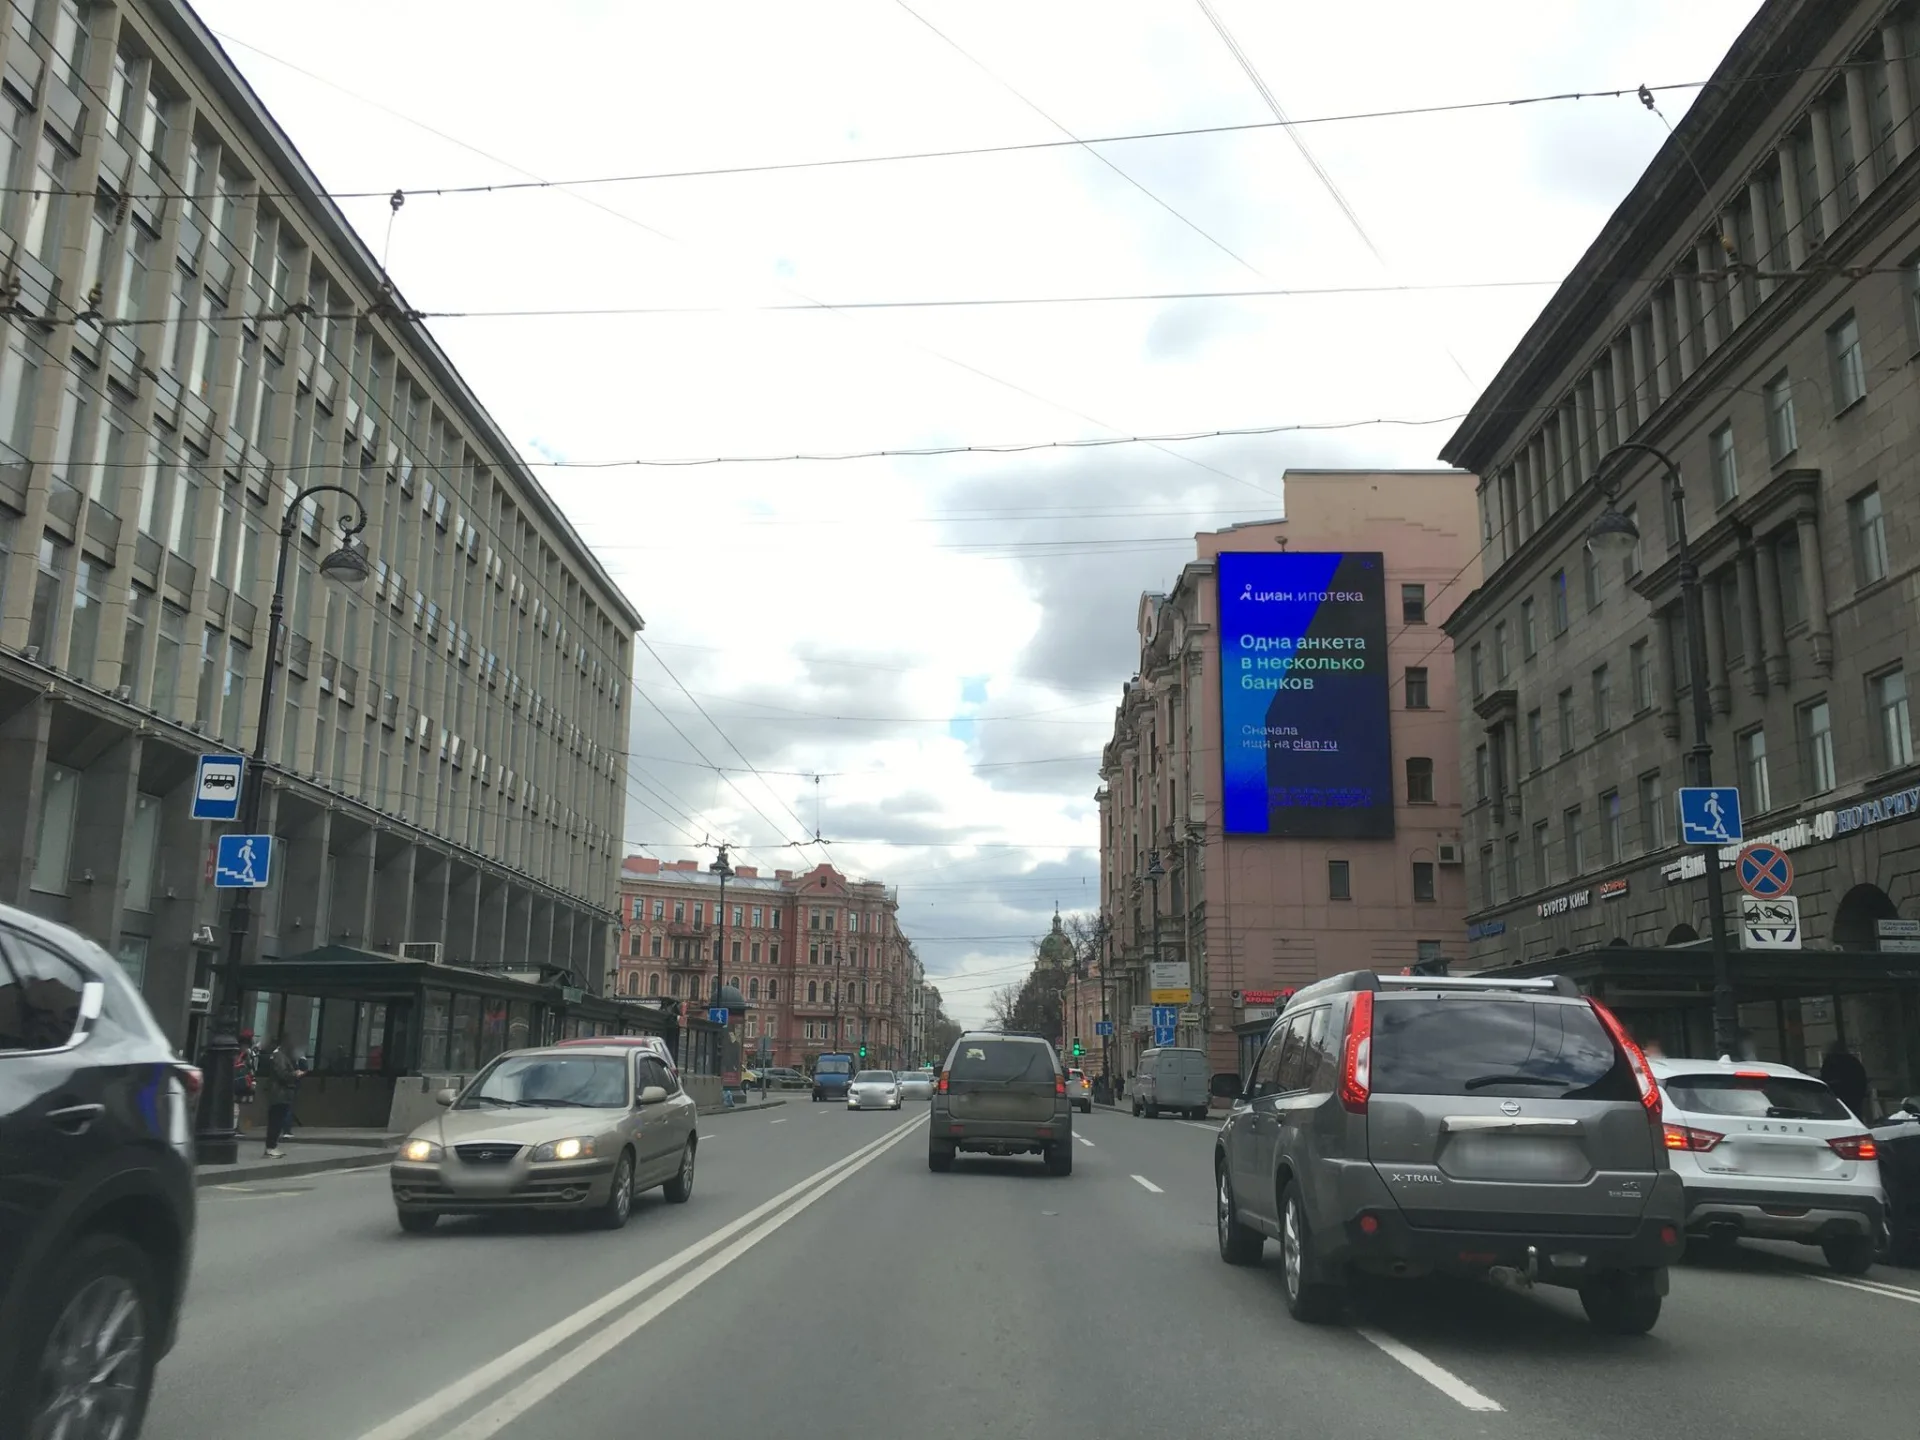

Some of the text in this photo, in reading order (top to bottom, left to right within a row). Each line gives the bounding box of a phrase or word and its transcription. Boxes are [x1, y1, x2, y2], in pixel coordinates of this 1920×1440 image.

[1240, 634, 1366, 651] Одна анкета
[1241, 657, 1365, 670] в несколько
[1241, 674, 1315, 690] банков
[1242, 724, 1298, 736] Сначала
[1242, 740, 1271, 750] ищи
[1274, 740, 1290, 749] на
[1542, 899, 1568, 917] БУРГЕР
[1569, 890, 1590, 909] КИНГ
[1747, 1123, 1805, 1133] LADA
[1391, 1173, 1443, 1184] X-TRAIL
